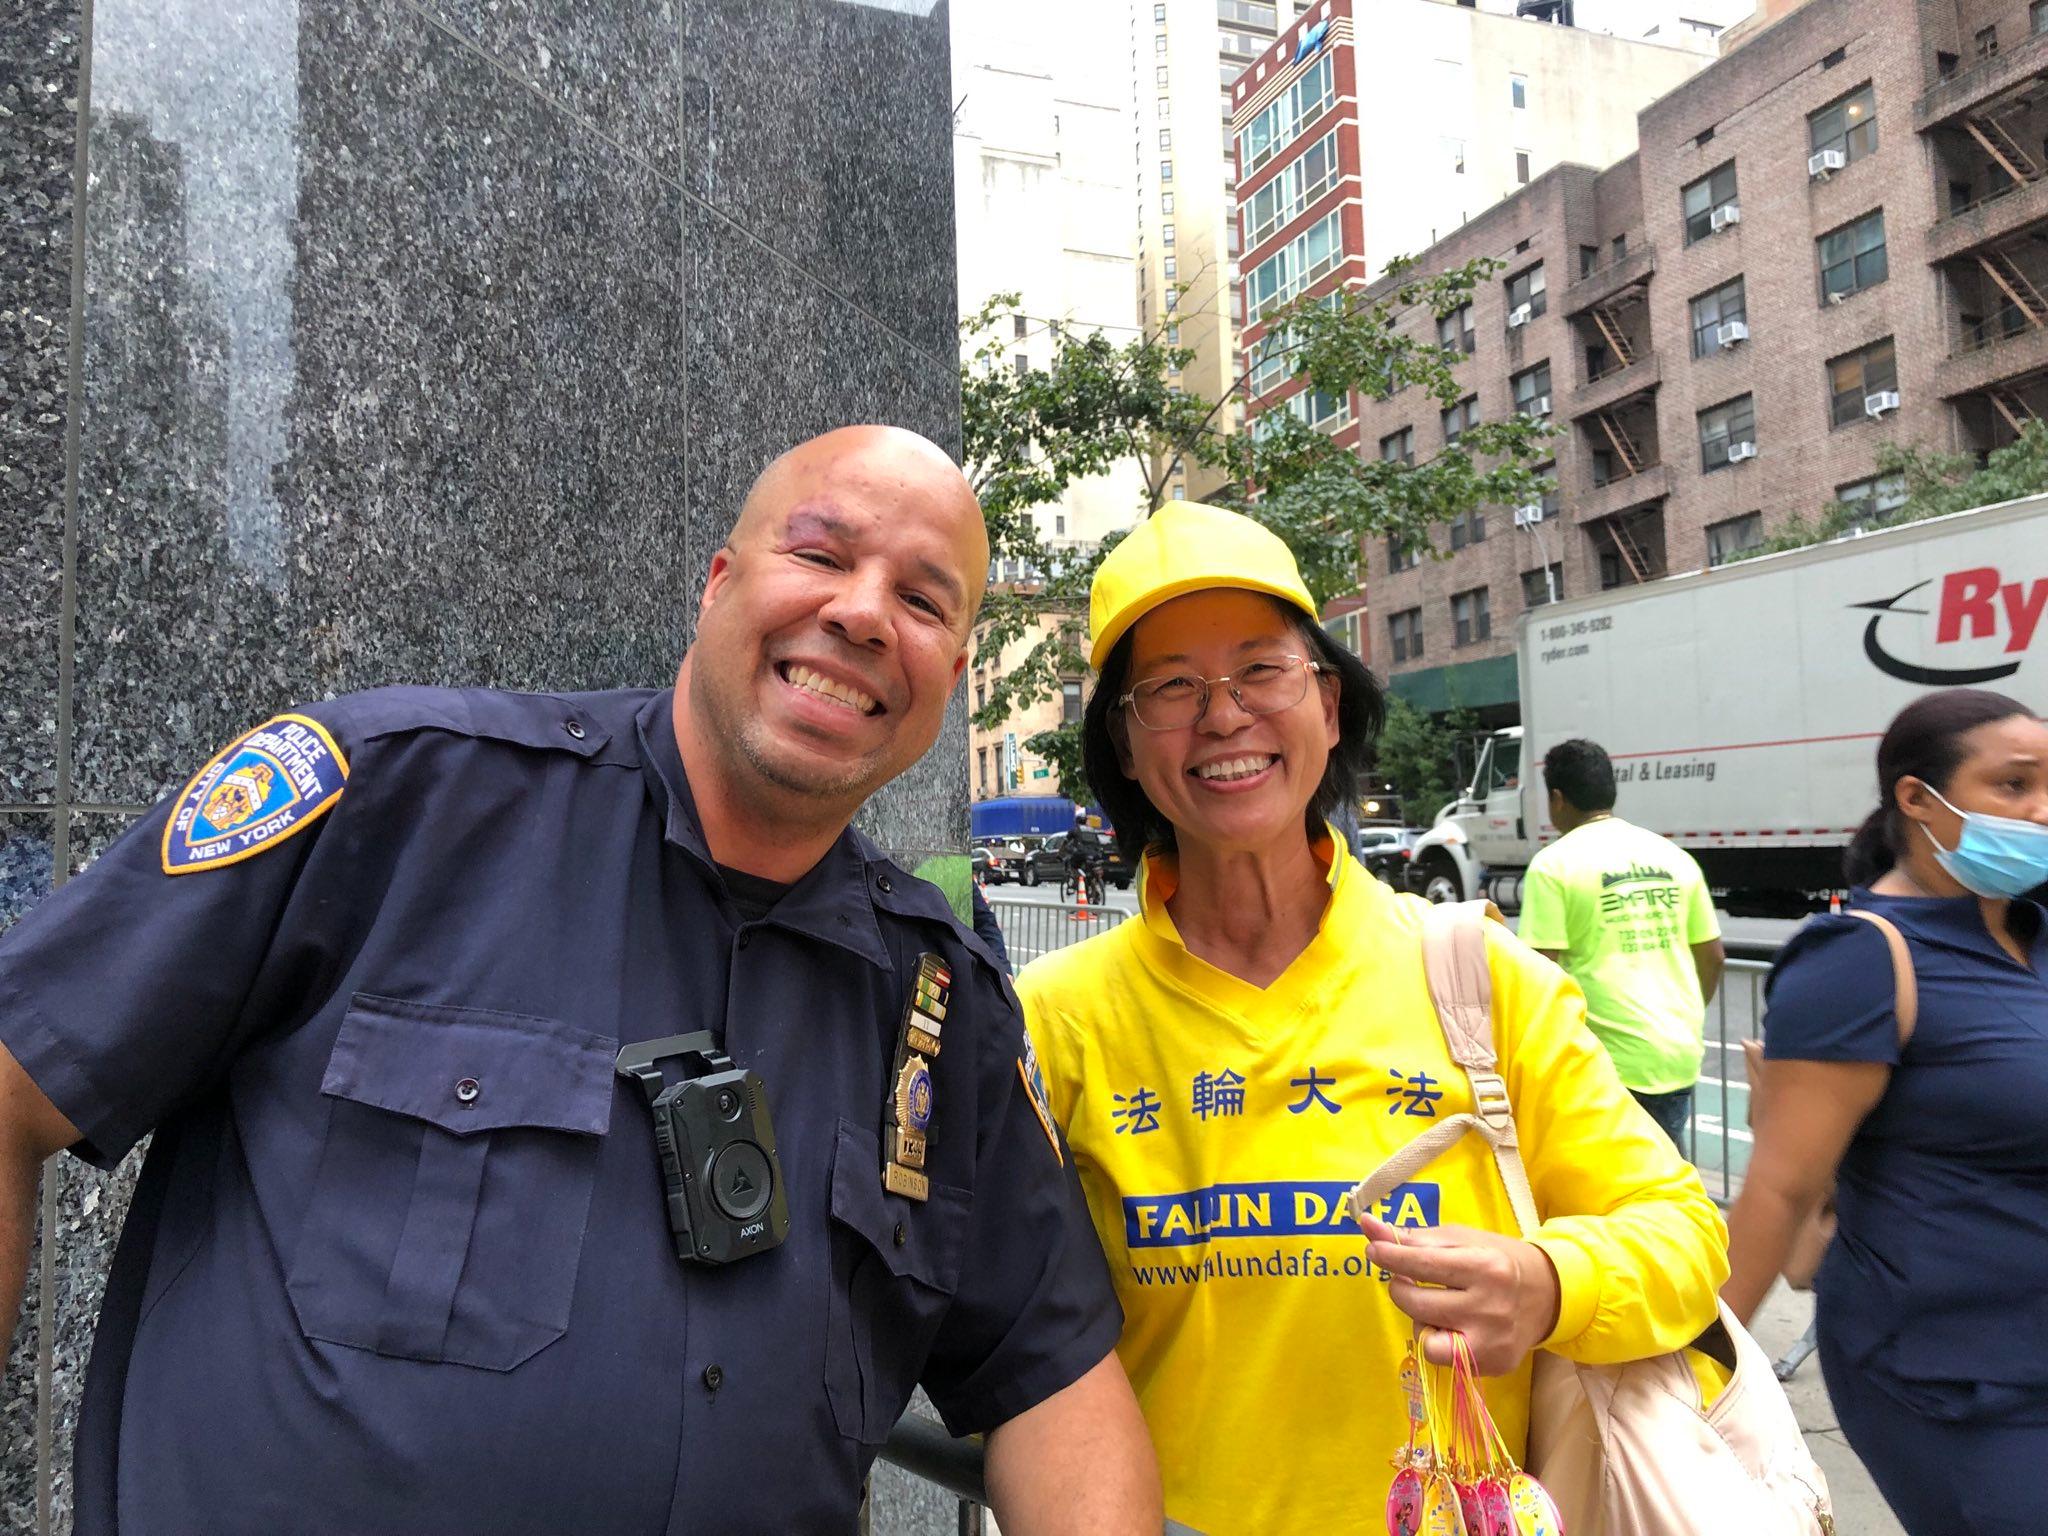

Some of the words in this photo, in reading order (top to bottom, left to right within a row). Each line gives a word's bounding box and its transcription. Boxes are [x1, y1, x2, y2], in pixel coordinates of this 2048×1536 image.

[278, 723, 327, 765] POLICE
[190, 762, 225, 800] CITY
[243, 732, 323, 800] DEPARTMENT
[1639, 762, 1650, 781] &
[1656, 758, 1716, 782] Leasing
[176, 807, 193, 831] OF
[189, 839, 231, 860] NEW
[239, 810, 295, 845] YORK
[1112, 1067, 1443, 1135] 法輪大法
[740, 1222, 764, 1239] AXON
[1136, 1193, 1272, 1239] FALUN
